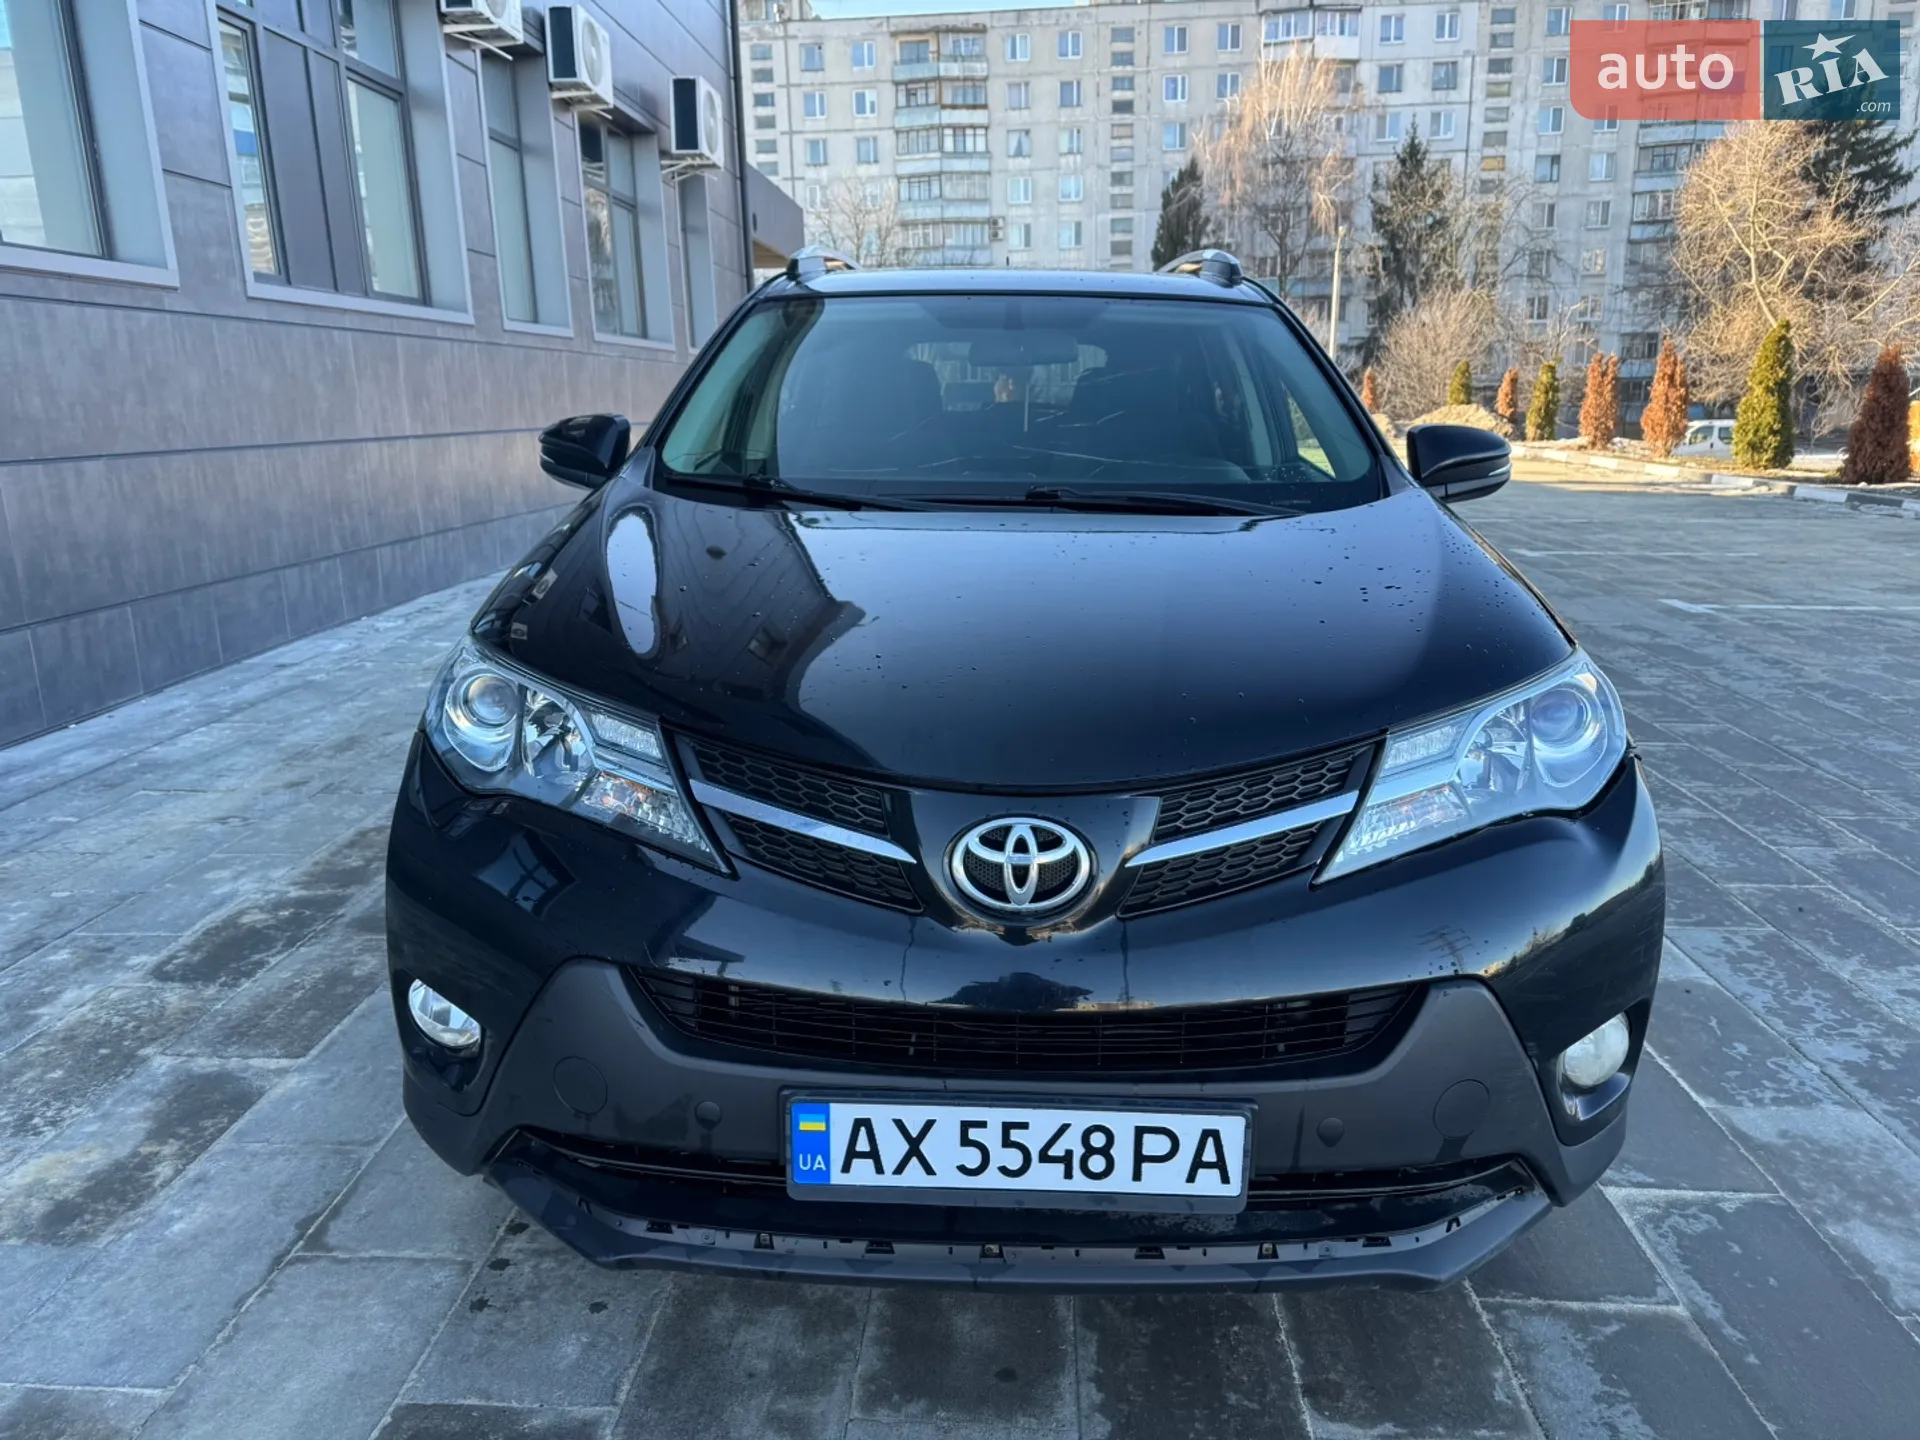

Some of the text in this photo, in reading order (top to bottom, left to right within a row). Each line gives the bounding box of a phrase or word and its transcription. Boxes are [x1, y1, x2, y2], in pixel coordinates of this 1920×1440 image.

[799, 1153, 826, 1171] UA
[841, 1117, 1231, 1184] AX 5548 PA
